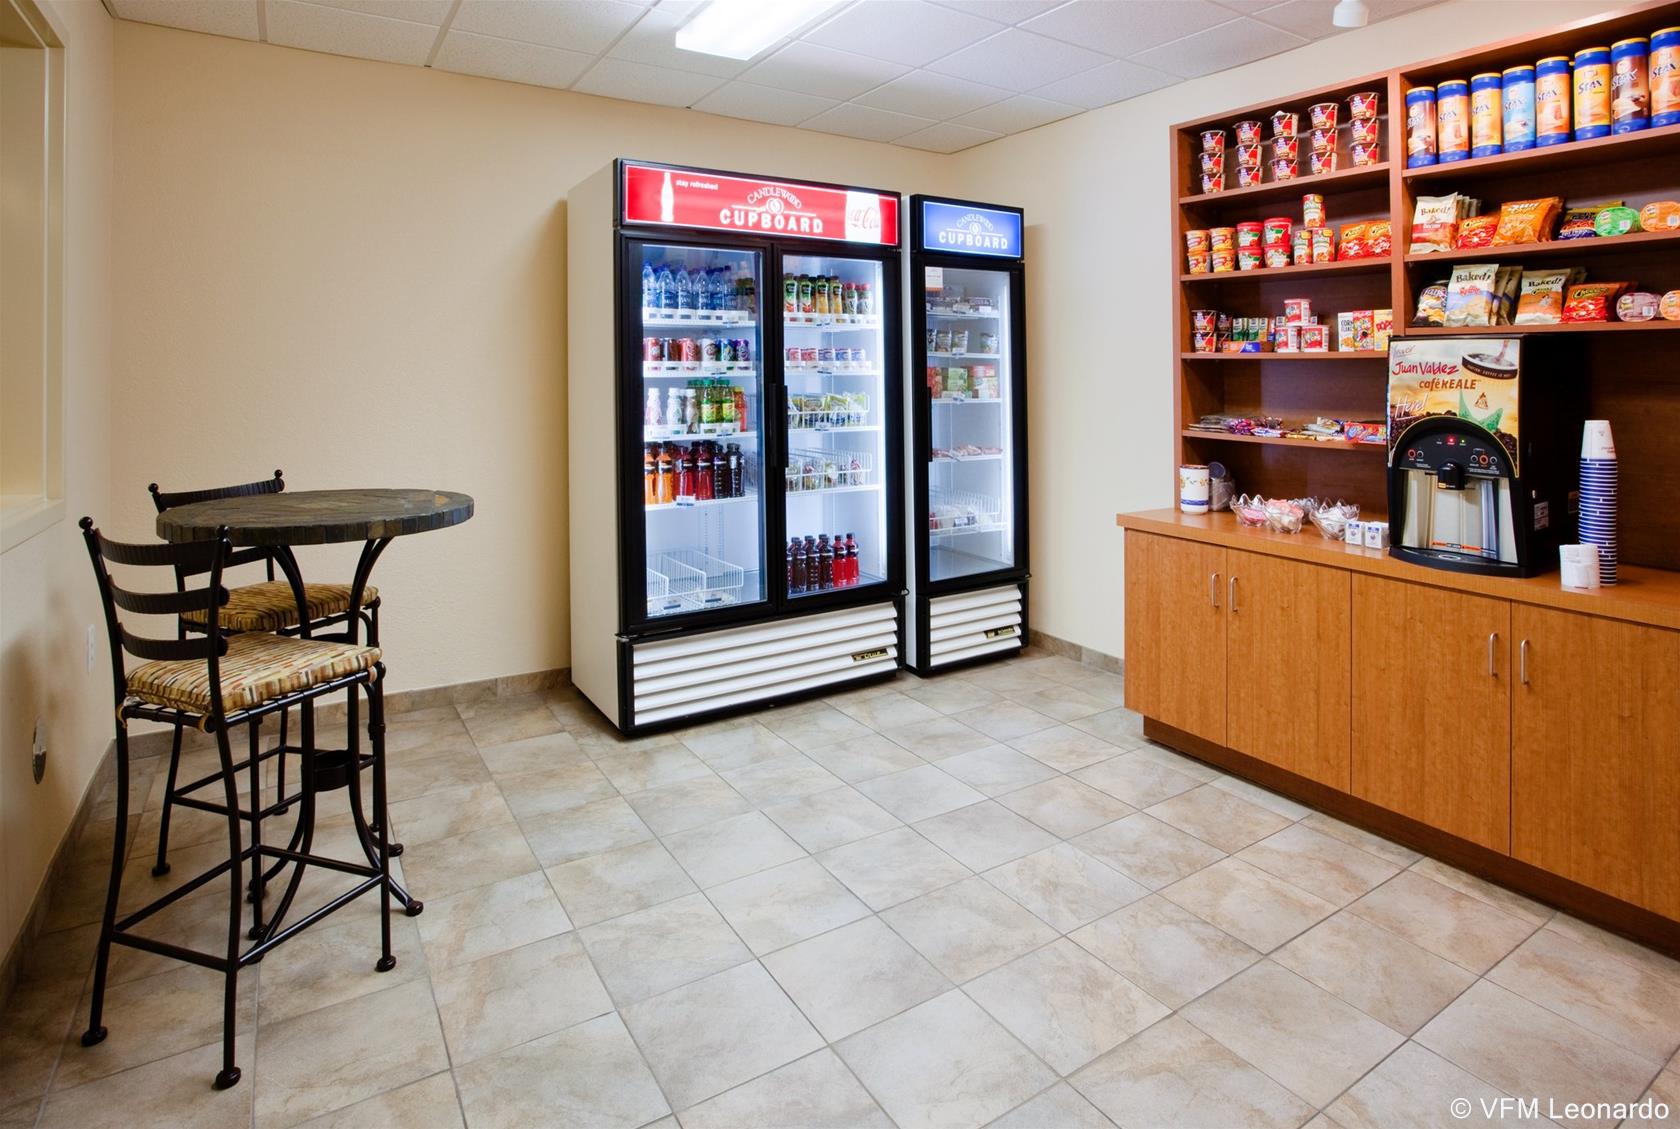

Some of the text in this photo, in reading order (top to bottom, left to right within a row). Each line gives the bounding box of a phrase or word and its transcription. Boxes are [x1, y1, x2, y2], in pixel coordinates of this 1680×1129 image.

[675, 179, 719, 191] stay refreshed
[719, 208, 824, 234] CUPBOARD
[938, 231, 1009, 250] CUPBOARD
[1392, 361, 1418, 375] Juan
[1419, 361, 1460, 375] Valdez
